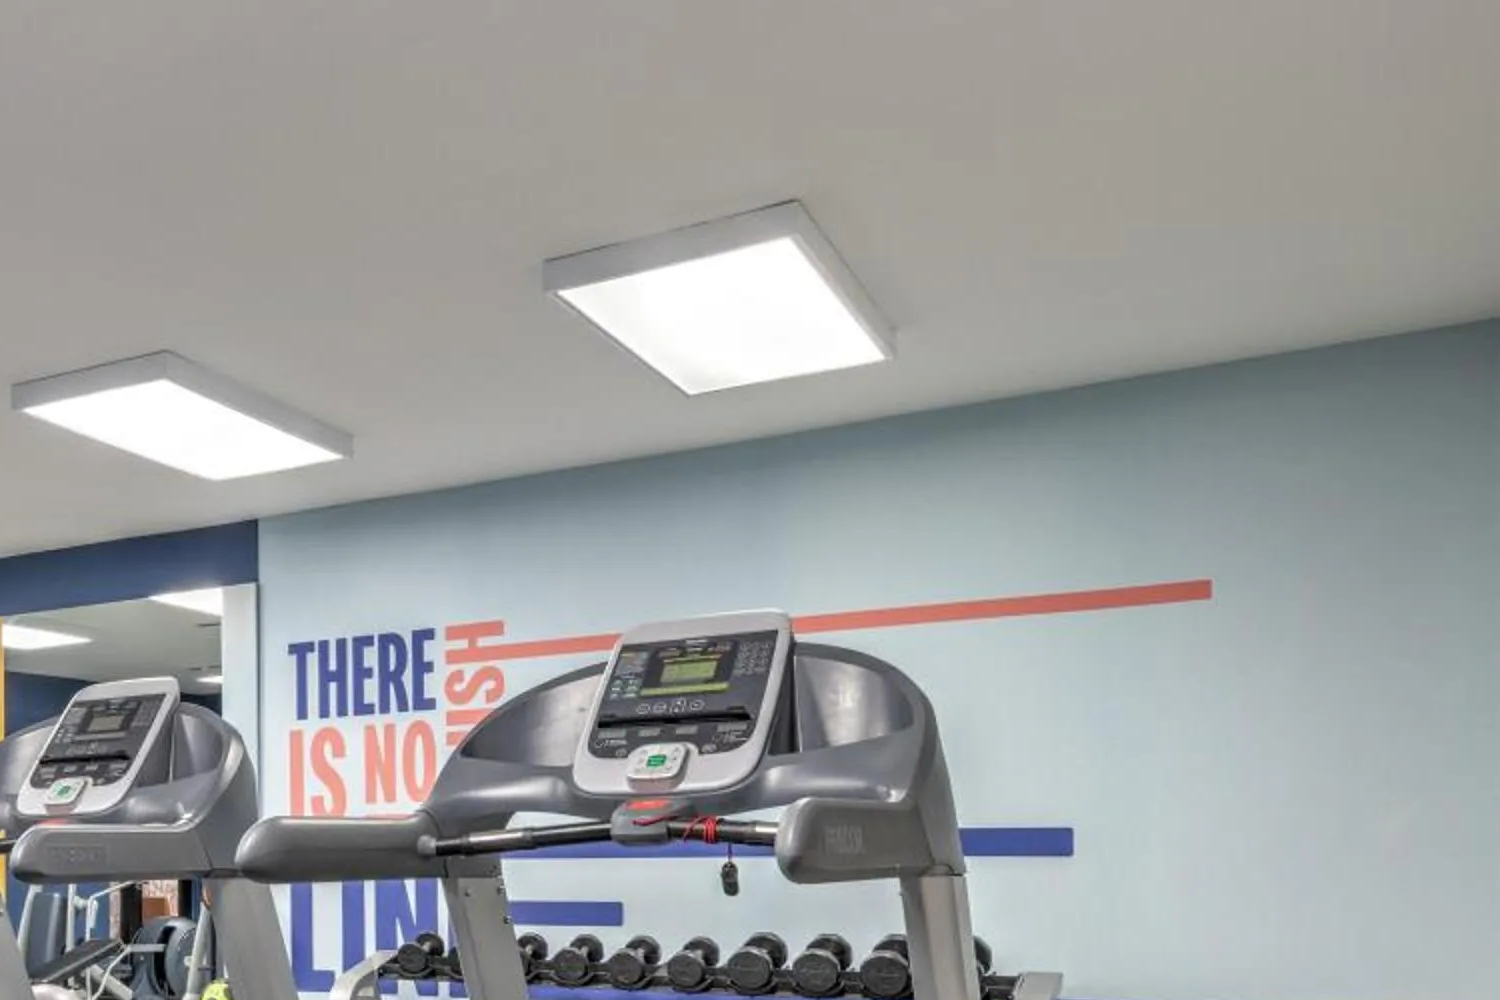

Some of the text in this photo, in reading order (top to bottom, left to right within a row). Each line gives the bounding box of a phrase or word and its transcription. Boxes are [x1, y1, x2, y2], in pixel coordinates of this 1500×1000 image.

[288, 627, 437, 721] THERE
[290, 719, 438, 818] IS NO
[290, 878, 467, 998] LIN
